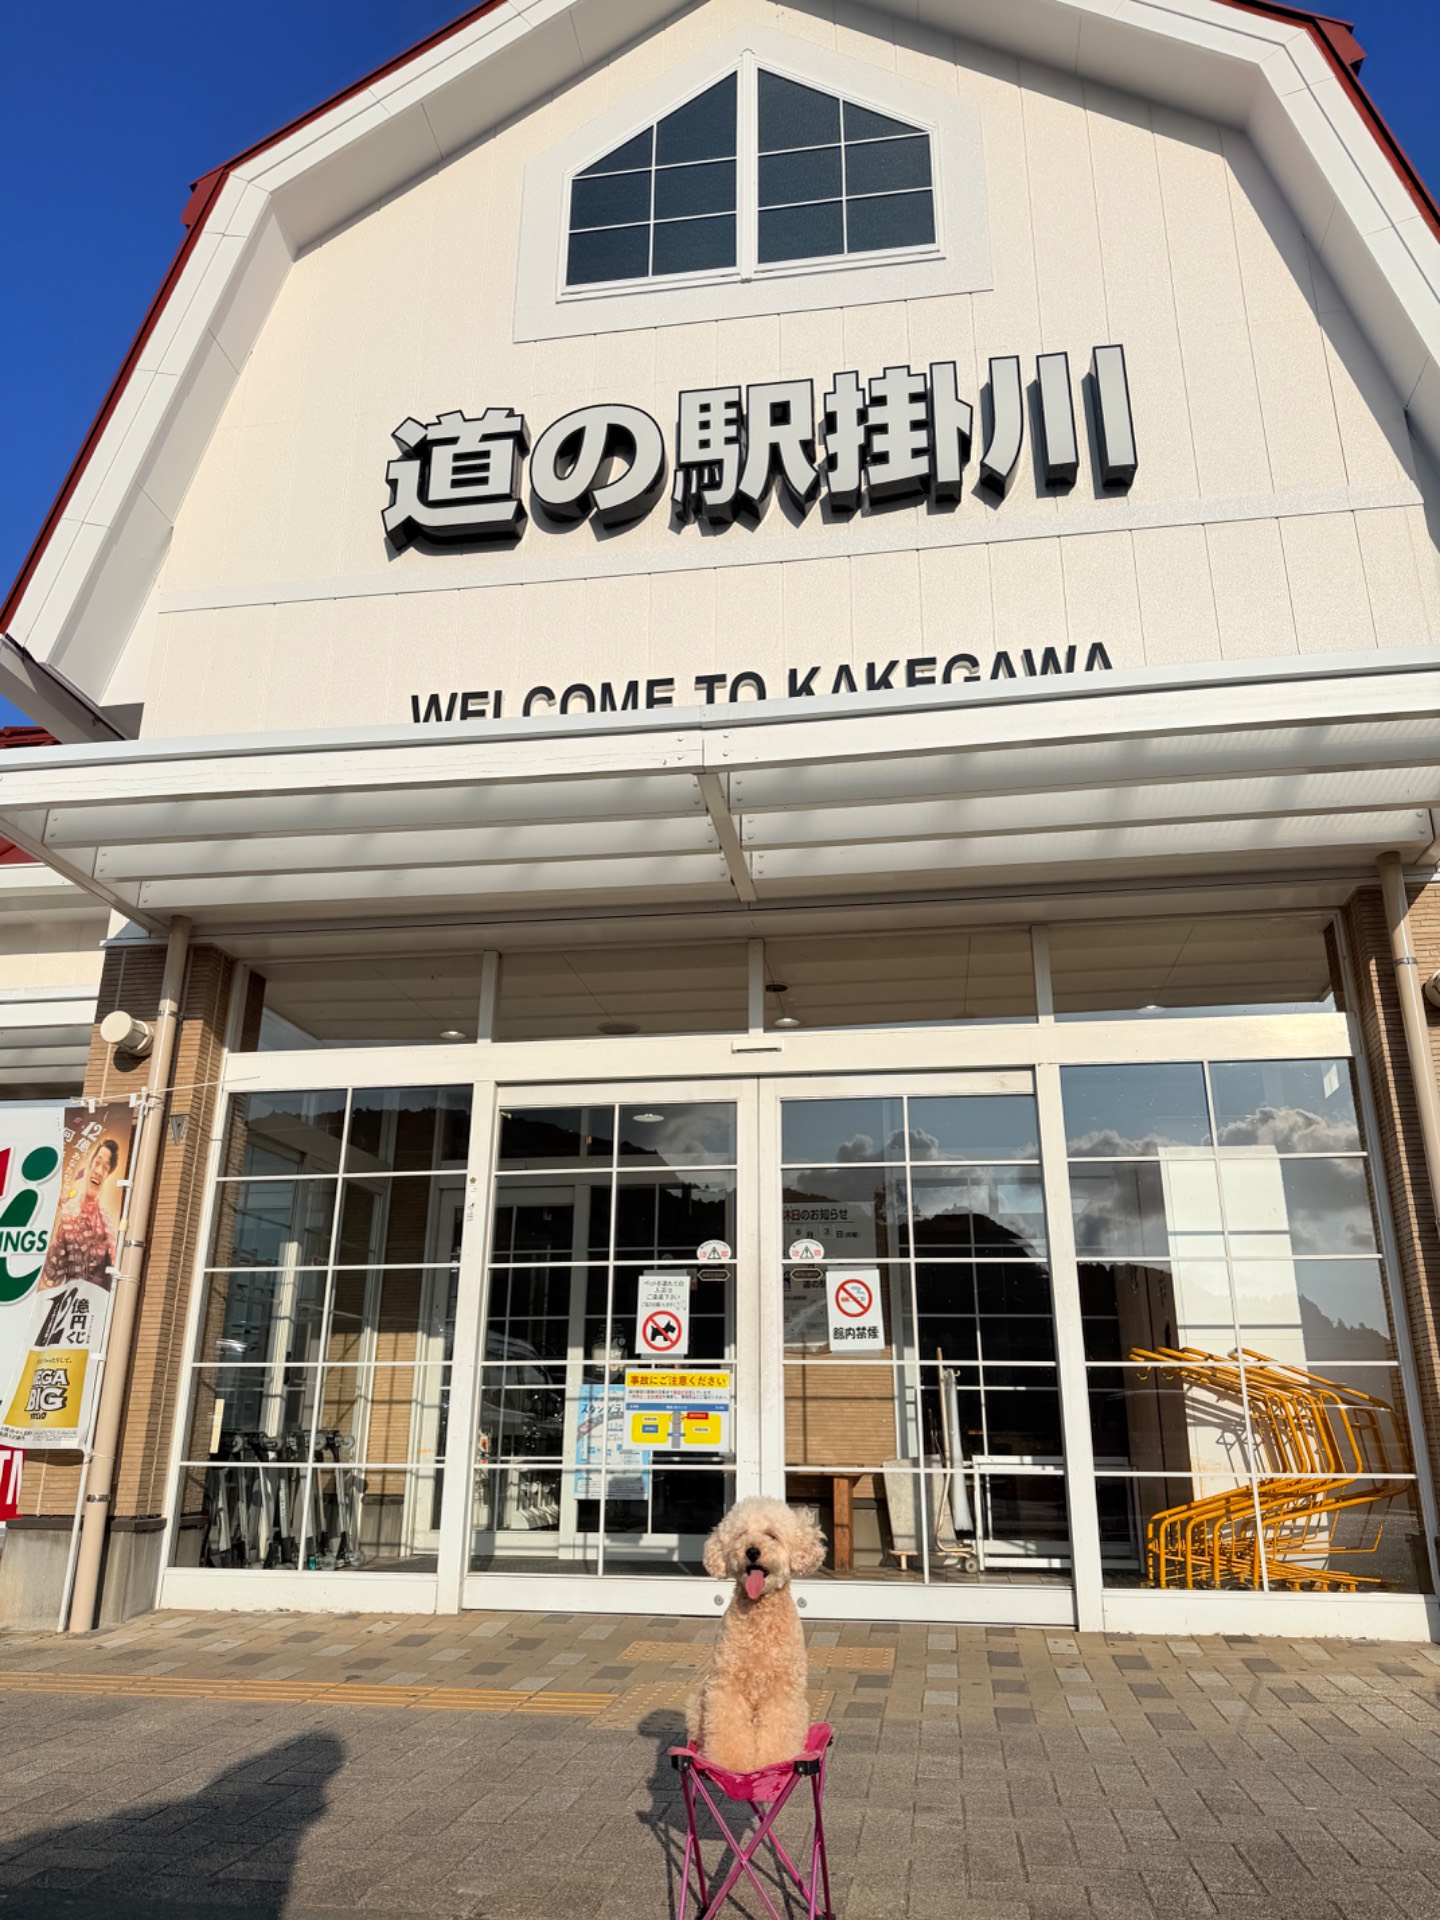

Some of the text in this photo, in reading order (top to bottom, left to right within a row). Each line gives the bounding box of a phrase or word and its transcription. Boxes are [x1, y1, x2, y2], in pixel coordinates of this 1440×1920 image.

[382, 344, 1139, 556] 道の駅掛川
[694, 670, 768, 705] TO
[787, 641, 1114, 698] KAKEGAWA
[833, 1326, 880, 1340] 館内禁煙
[32, 1368, 70, 1386] EGA
[630, 1375, 727, 1386] 事故にご注意ください
[24, 1387, 67, 1412] BIG
